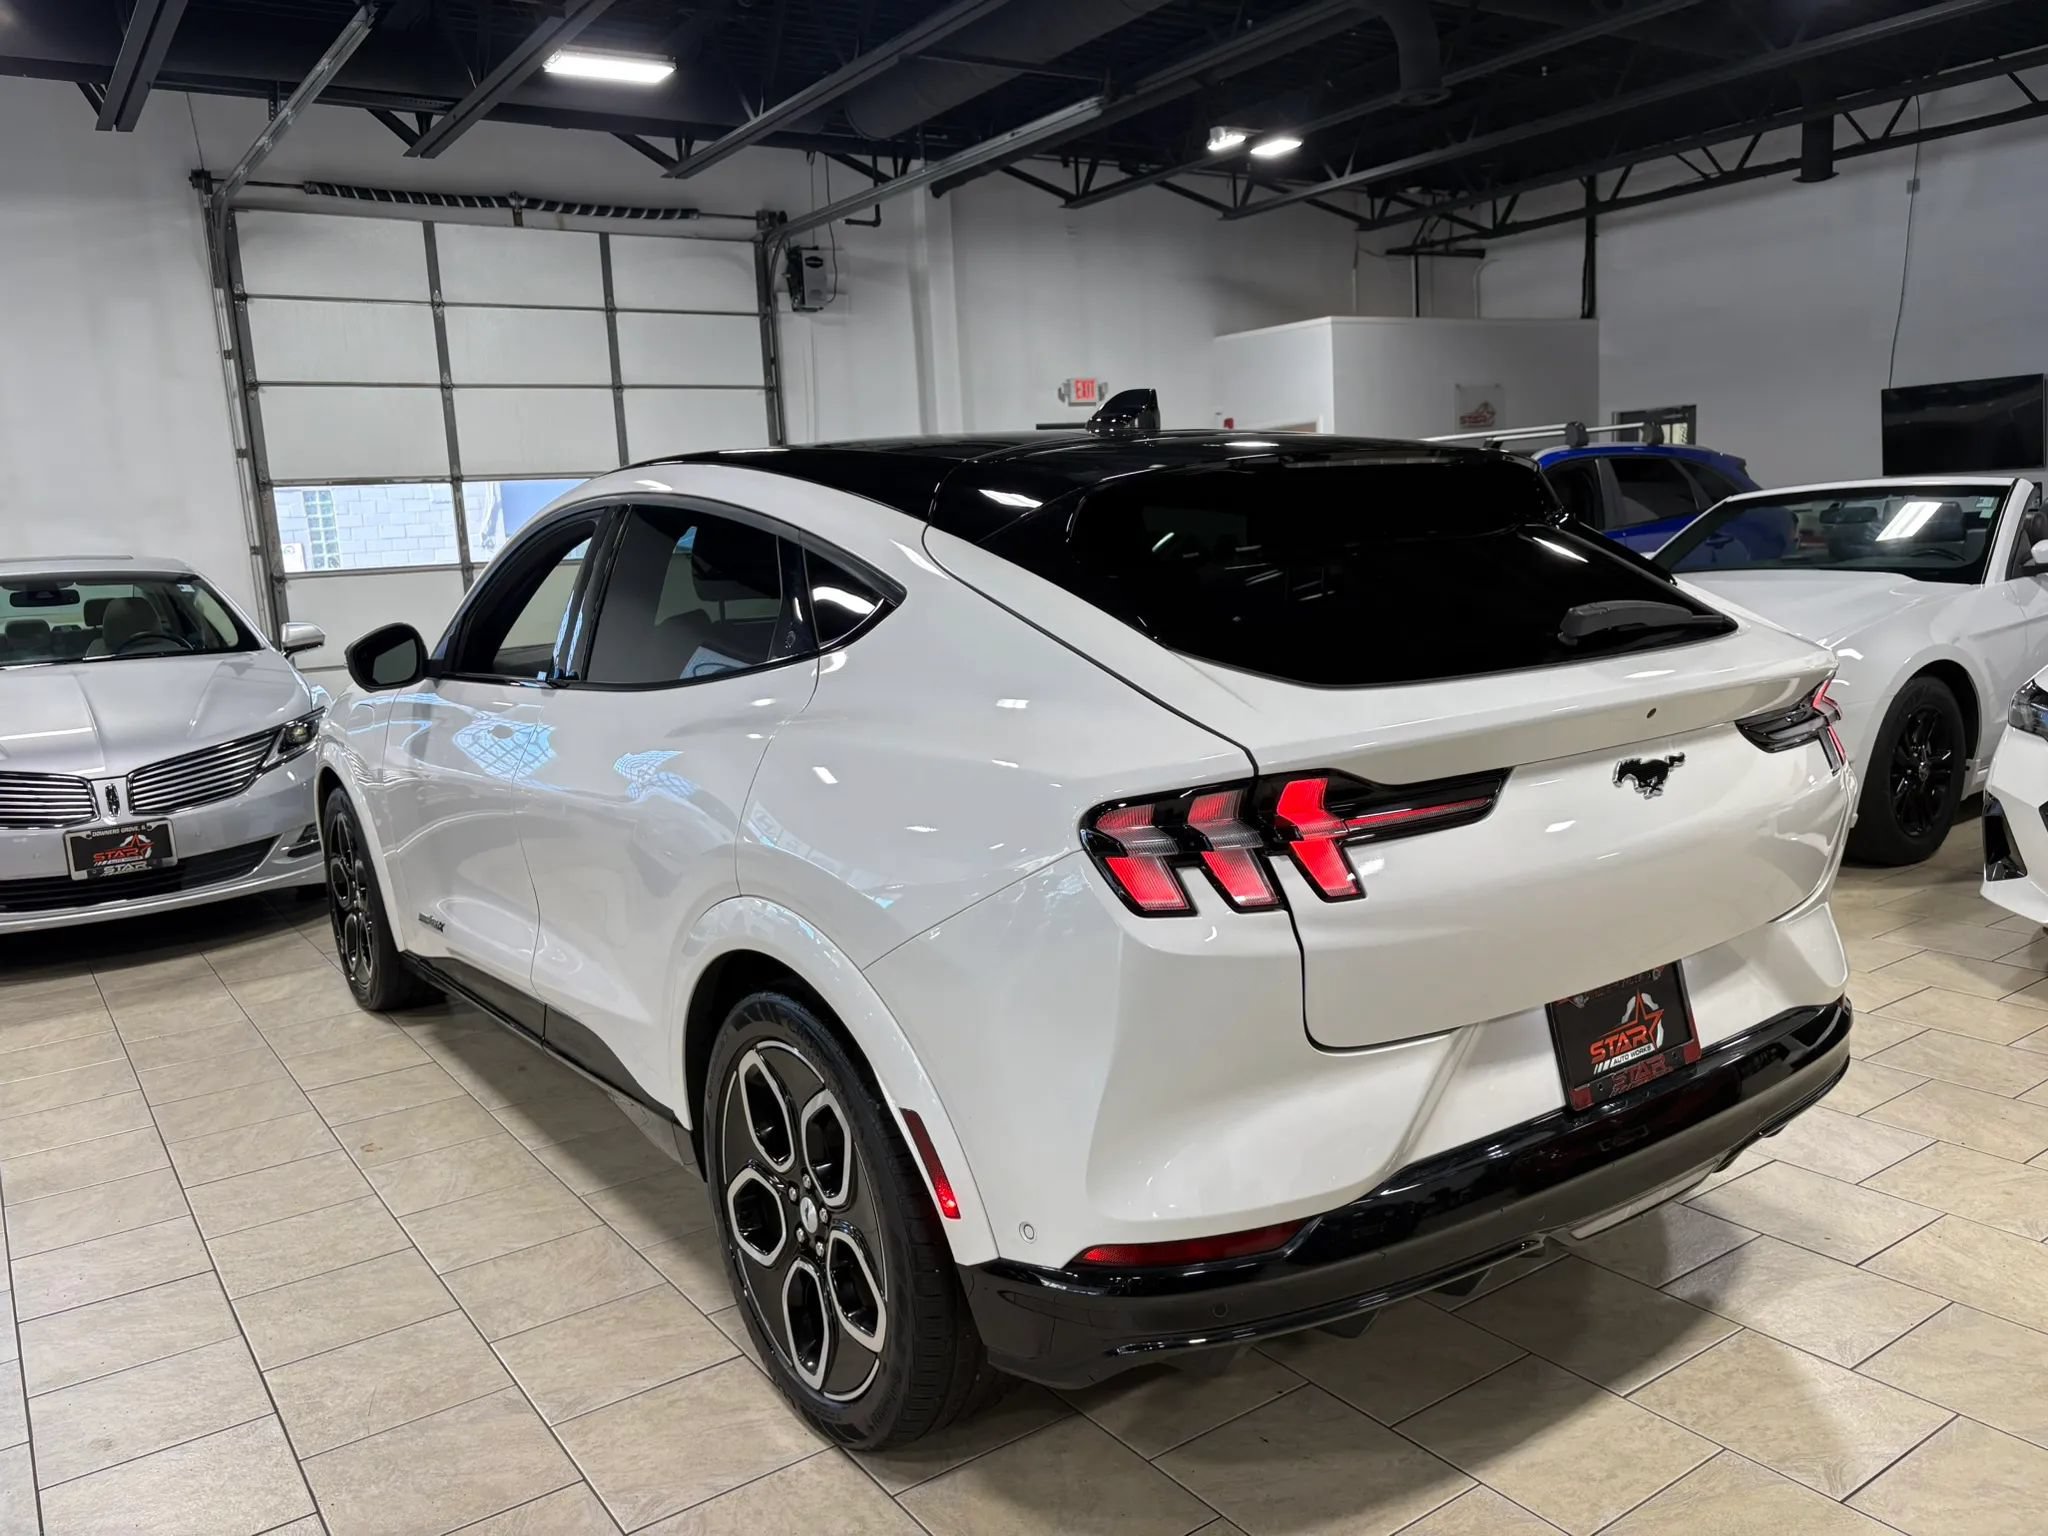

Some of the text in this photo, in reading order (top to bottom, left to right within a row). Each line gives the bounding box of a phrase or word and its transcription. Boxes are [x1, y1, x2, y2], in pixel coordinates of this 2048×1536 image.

[1075, 380, 1096, 400] EXIT
[92, 829, 120, 837] DOWNERS
[94, 848, 139, 861] STAR
[103, 862, 148, 875] STAR
[1590, 1025, 1650, 1064] STAR
[1613, 1045, 1652, 1064] AUTO WORKS
[1611, 1054, 1667, 1092] STAR
